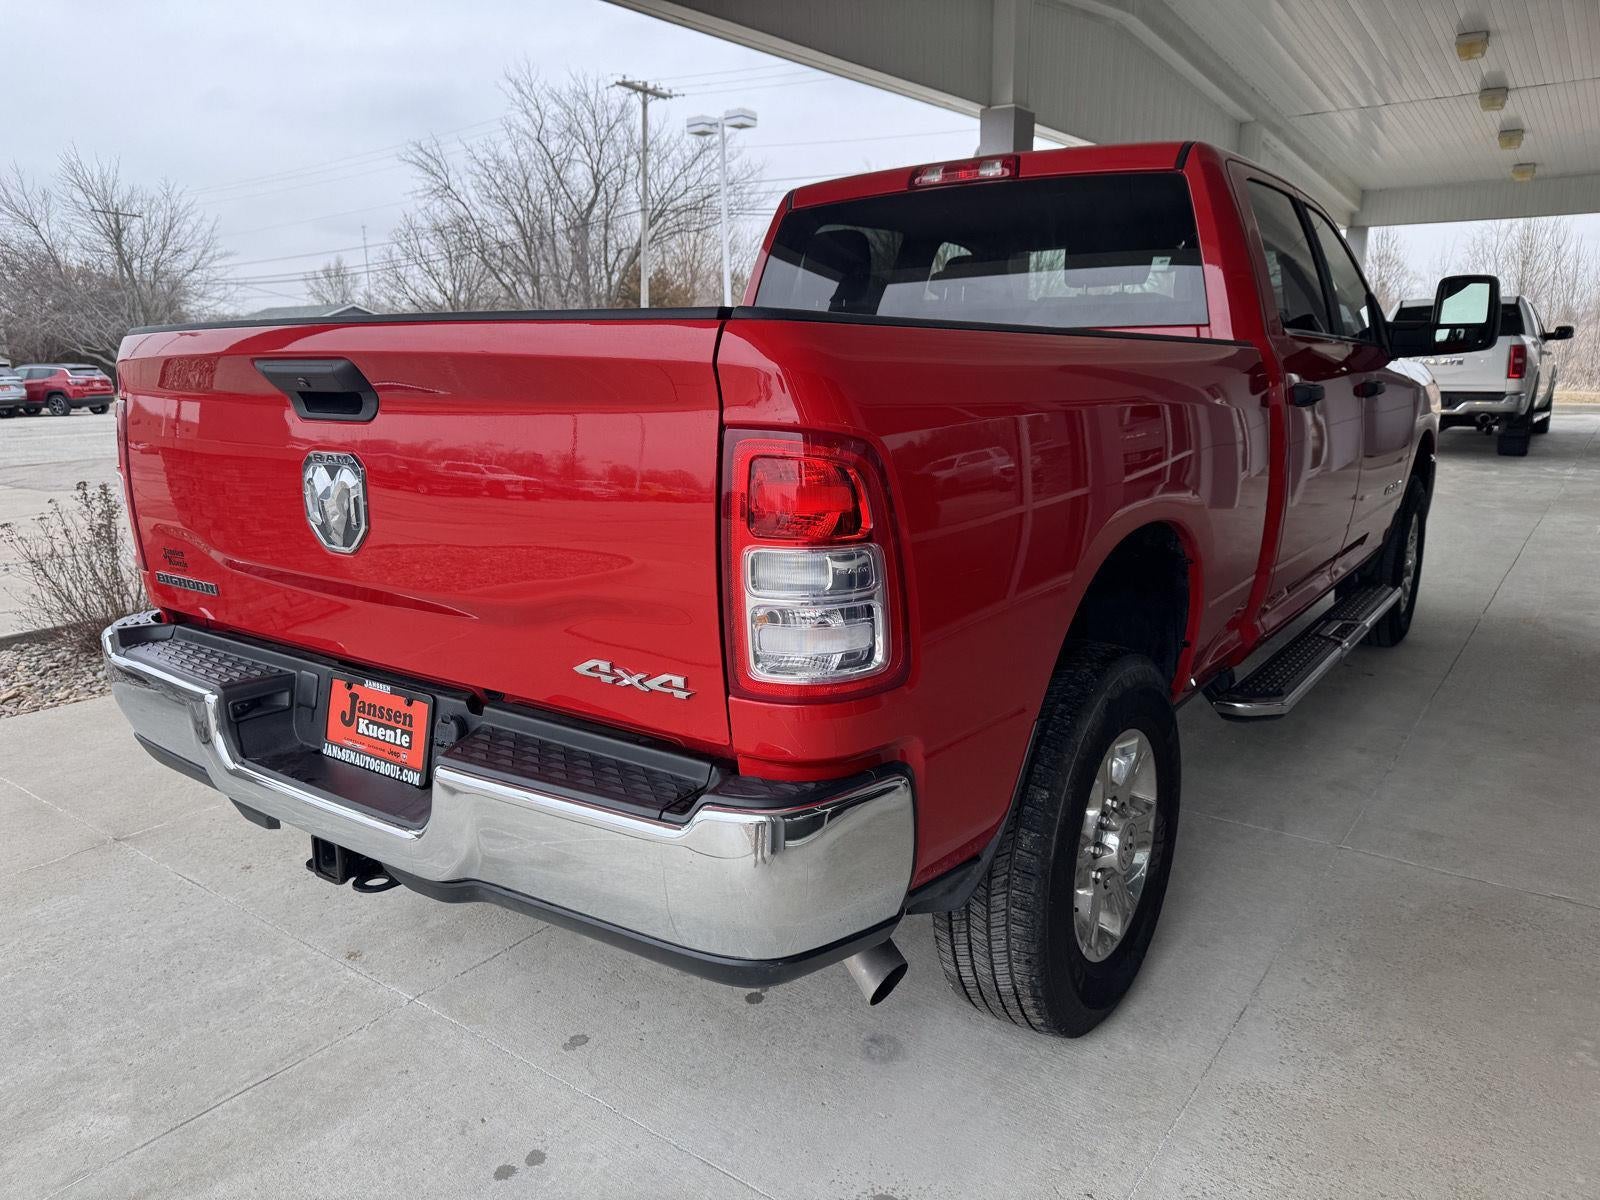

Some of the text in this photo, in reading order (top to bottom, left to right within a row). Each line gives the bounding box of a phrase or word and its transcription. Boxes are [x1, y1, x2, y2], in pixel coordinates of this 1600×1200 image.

[312, 453, 351, 464] RAM
[156, 572, 219, 595] BIGHORN
[341, 692, 413, 728] Janssen
[357, 718, 410, 747] Kuenle
